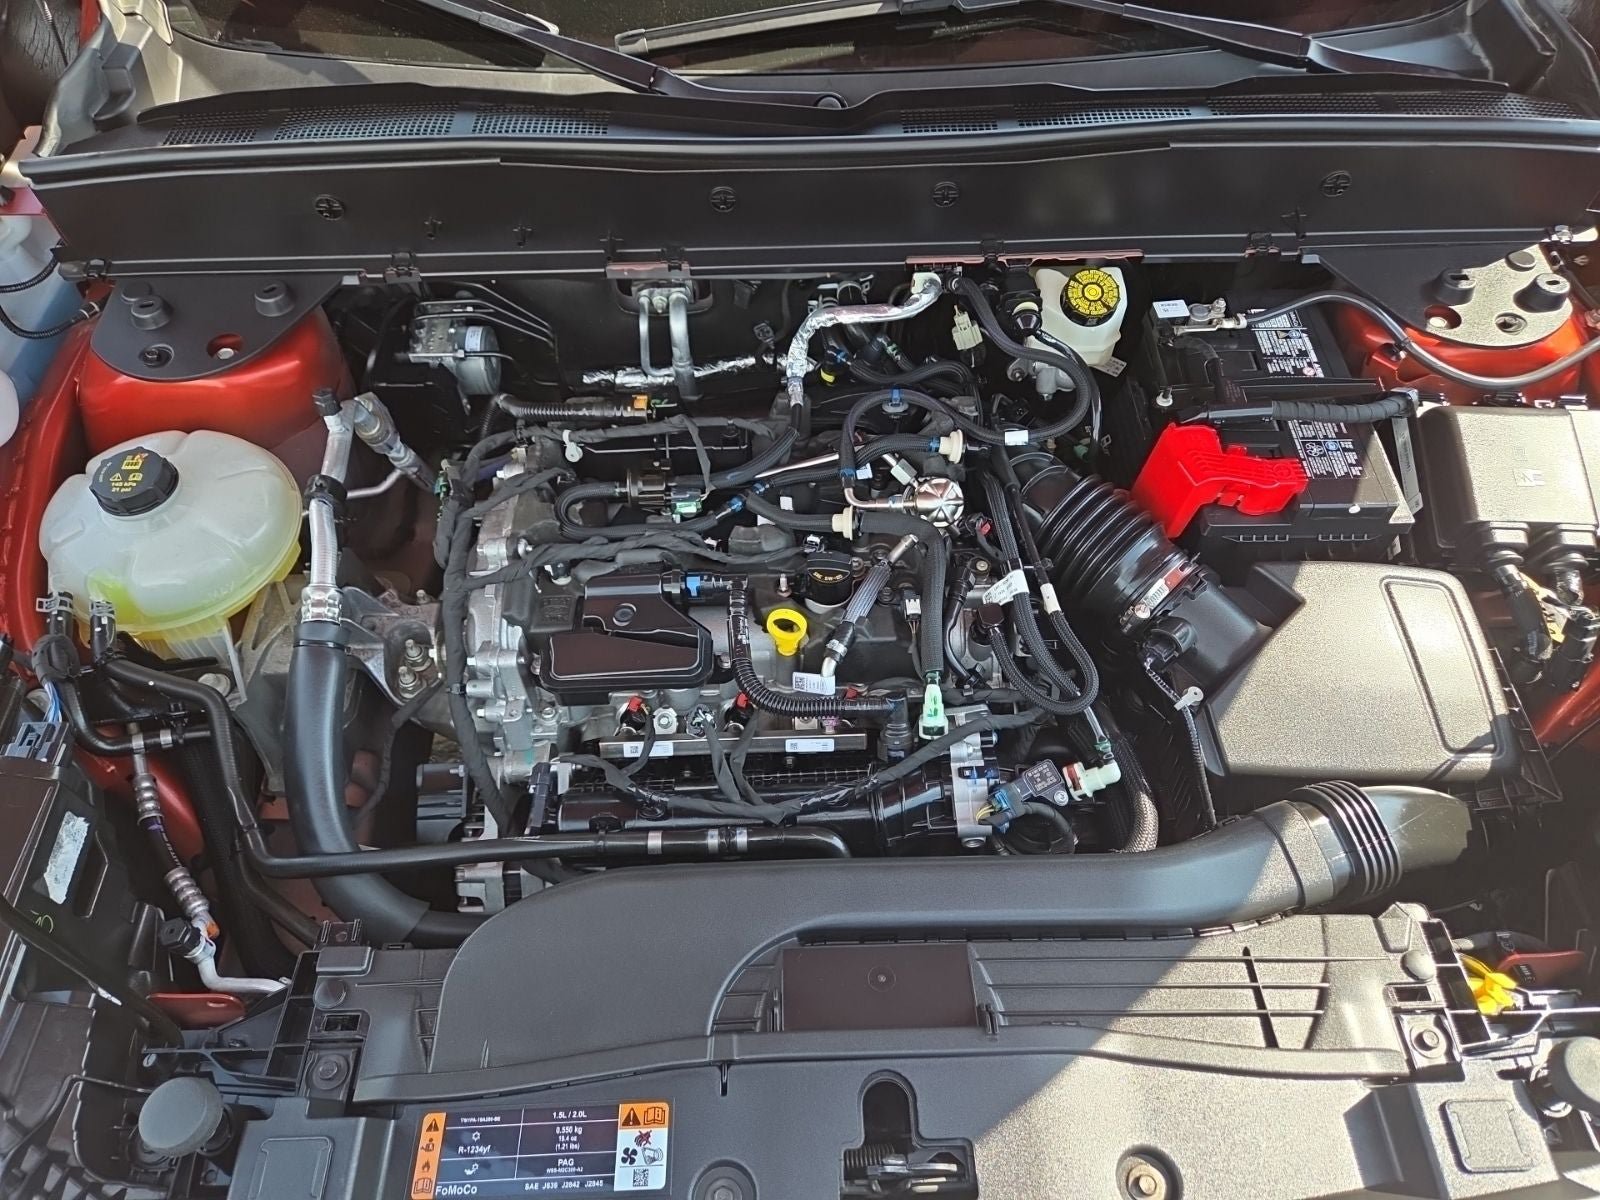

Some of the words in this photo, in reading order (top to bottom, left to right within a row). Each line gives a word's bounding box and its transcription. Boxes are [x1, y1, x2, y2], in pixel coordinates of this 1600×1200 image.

[552, 1111, 567, 1119] 1.5L
[572, 1110, 587, 1118] 2.0L
[555, 1125, 573, 1134] 0.550
[574, 1125, 583, 1135] kg
[458, 1144, 491, 1155] R-1234yf
[557, 1158, 574, 1167] PAG
[435, 1183, 478, 1196] FoMoCo
[525, 1182, 539, 1191] SAE
